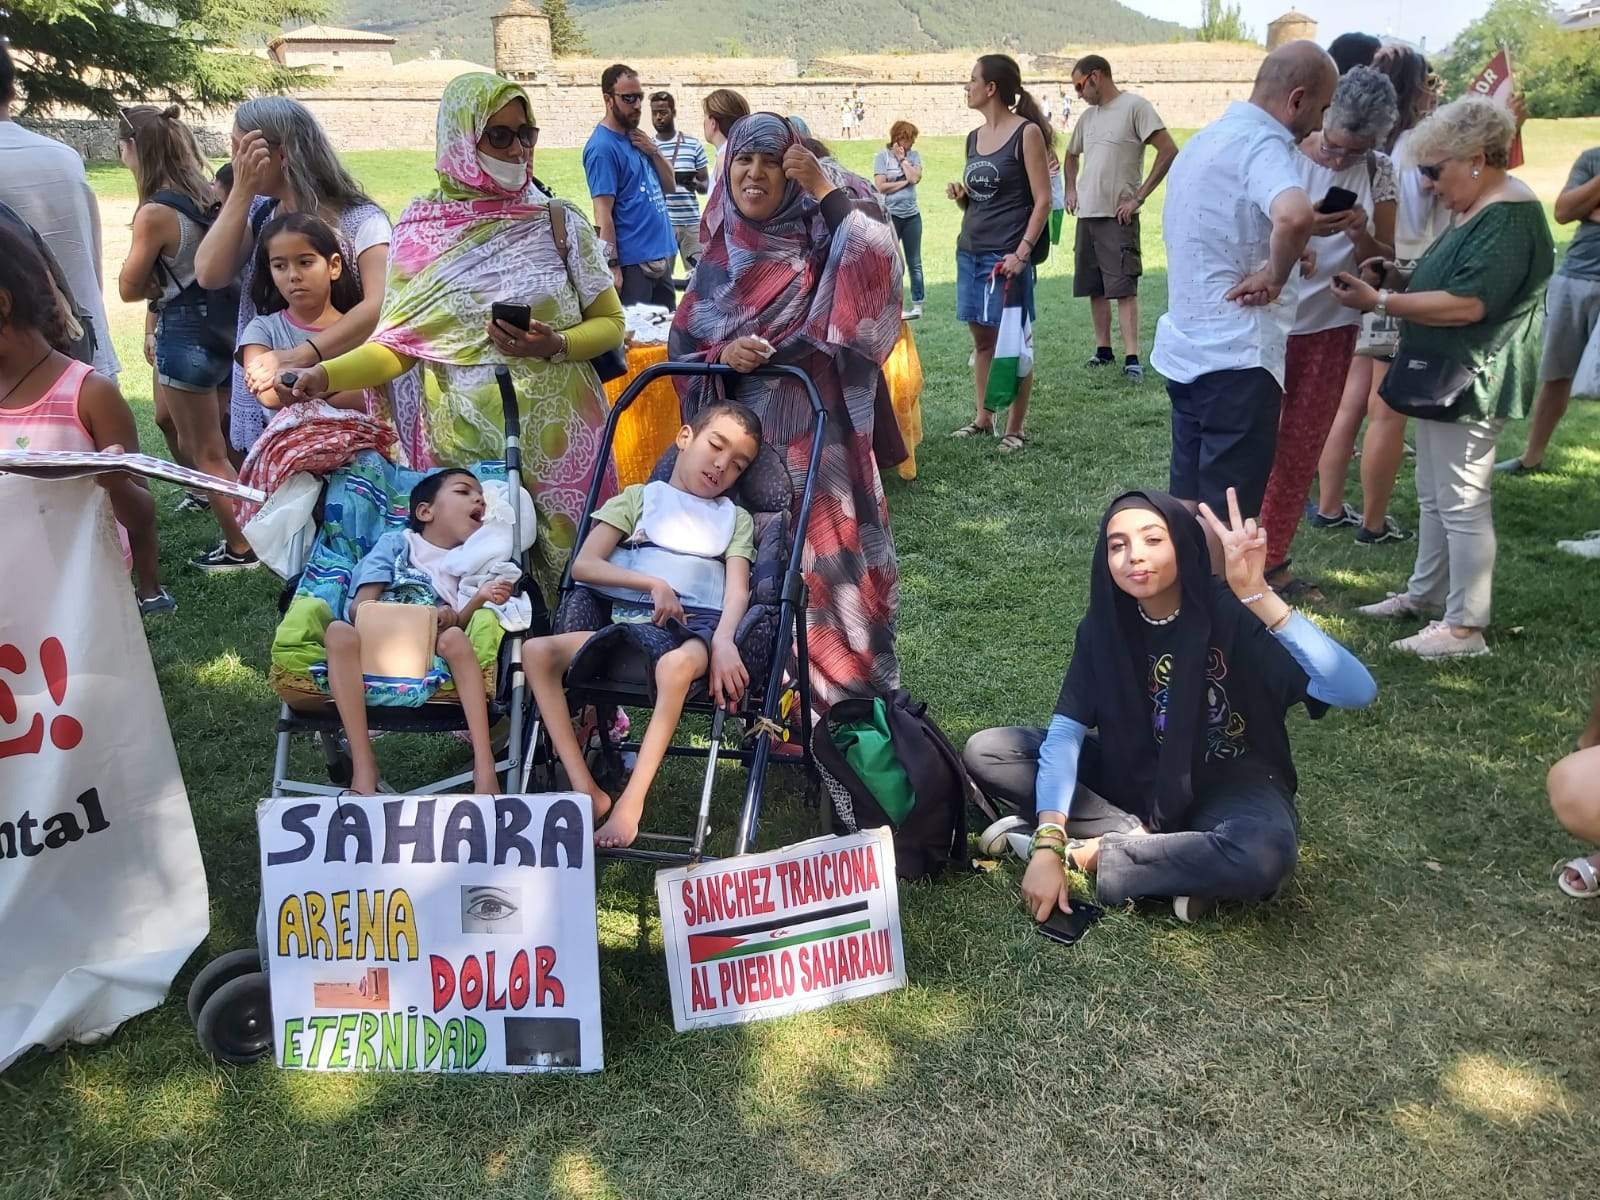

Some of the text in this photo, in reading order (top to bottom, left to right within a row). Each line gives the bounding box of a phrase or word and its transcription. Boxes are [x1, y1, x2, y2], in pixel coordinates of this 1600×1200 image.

[267, 797, 584, 869] SAHARA
[681, 845, 880, 927] SANCHEZ TRAICIONA
[277, 888, 420, 962] ARENA
[429, 945, 565, 1013] DOLOR
[691, 928, 894, 1012] AL PUEBLO SAHARAUI
